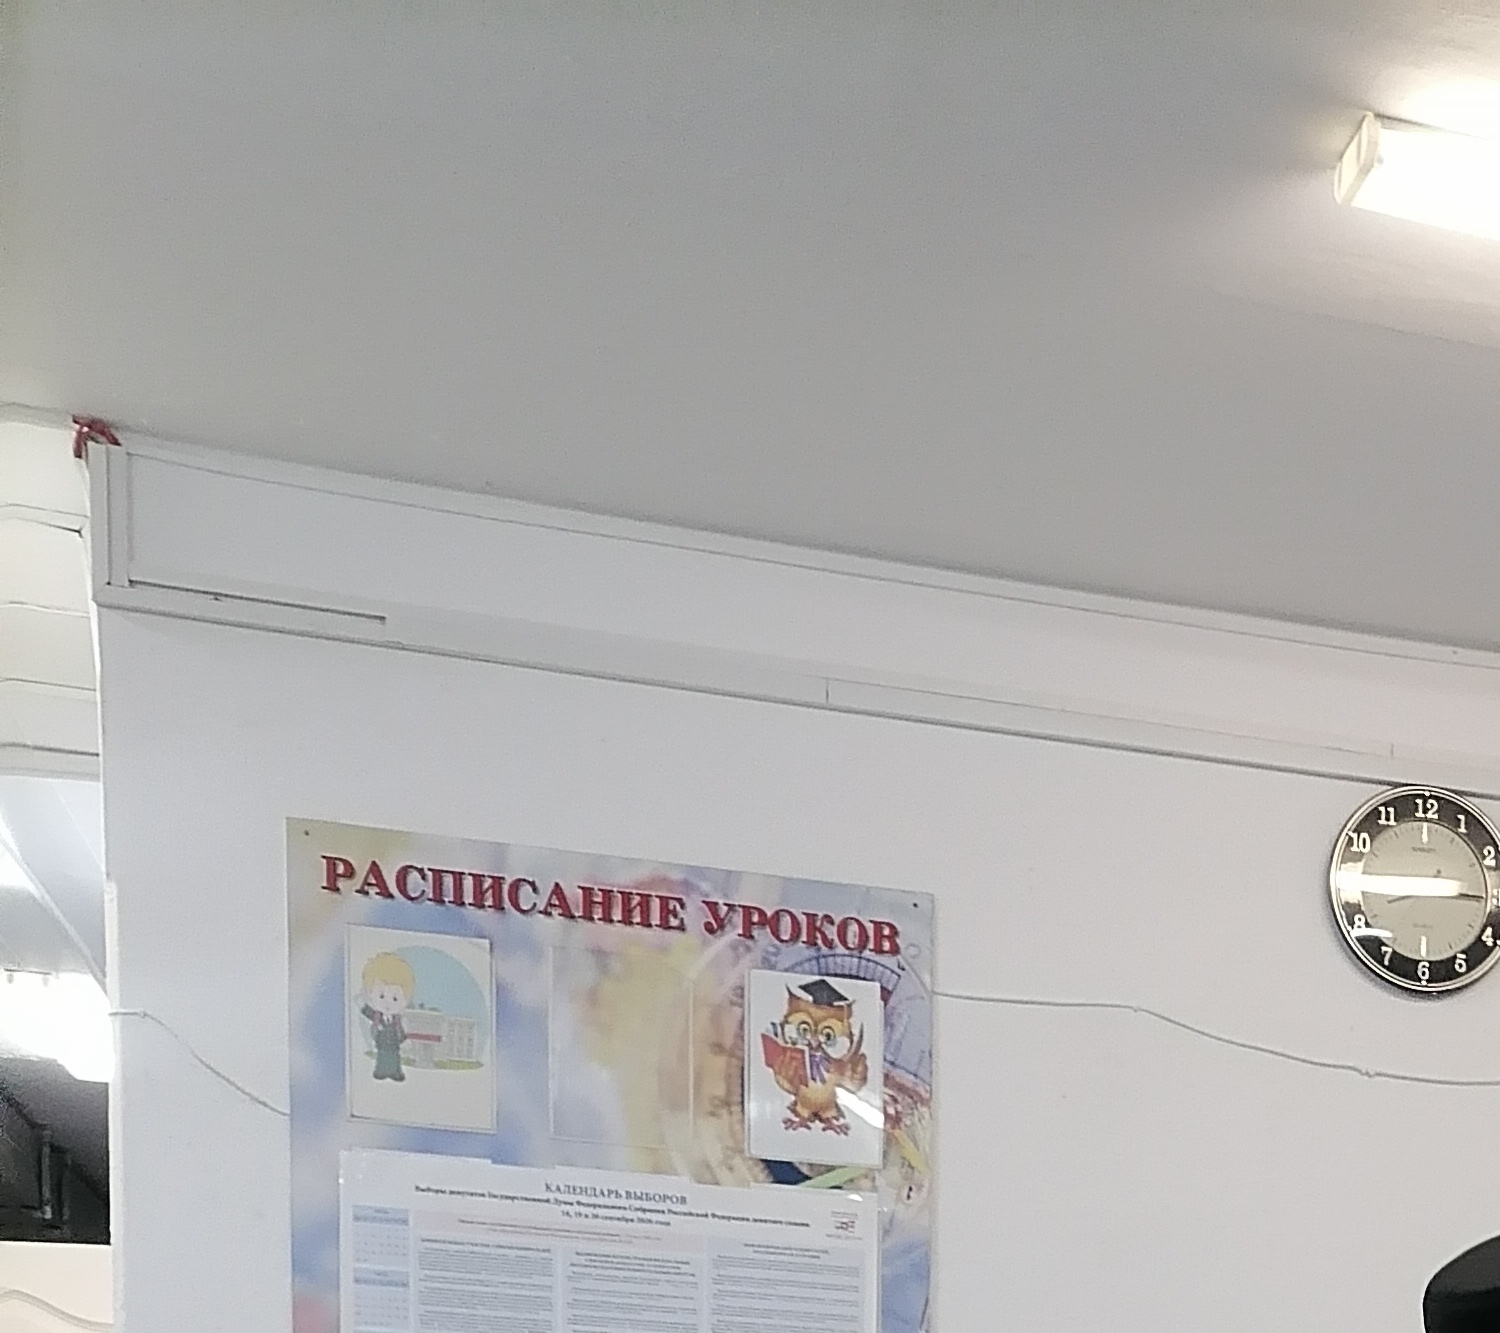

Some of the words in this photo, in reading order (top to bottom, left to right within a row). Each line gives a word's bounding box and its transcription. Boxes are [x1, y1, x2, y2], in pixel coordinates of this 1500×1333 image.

[1378, 806, 1396, 825] 11
[1414, 799, 1439, 818] 12
[1457, 815, 1467, 833] 1
[1350, 833, 1370, 852] 10
[1483, 846, 1496, 866] 2
[321, 854, 687, 932] РАСПИСАНИЕ
[703, 900, 901, 957] УРОКОВ
[1481, 927, 1493, 946] 4
[1381, 946, 1393, 965] 7
[1455, 953, 1467, 972] 5
[1417, 962, 1429, 980] 6
[544, 1182, 622, 1200] КАЛЕНДАРЬ
[625, 1190, 688, 1205] ВЫБОРОВ
